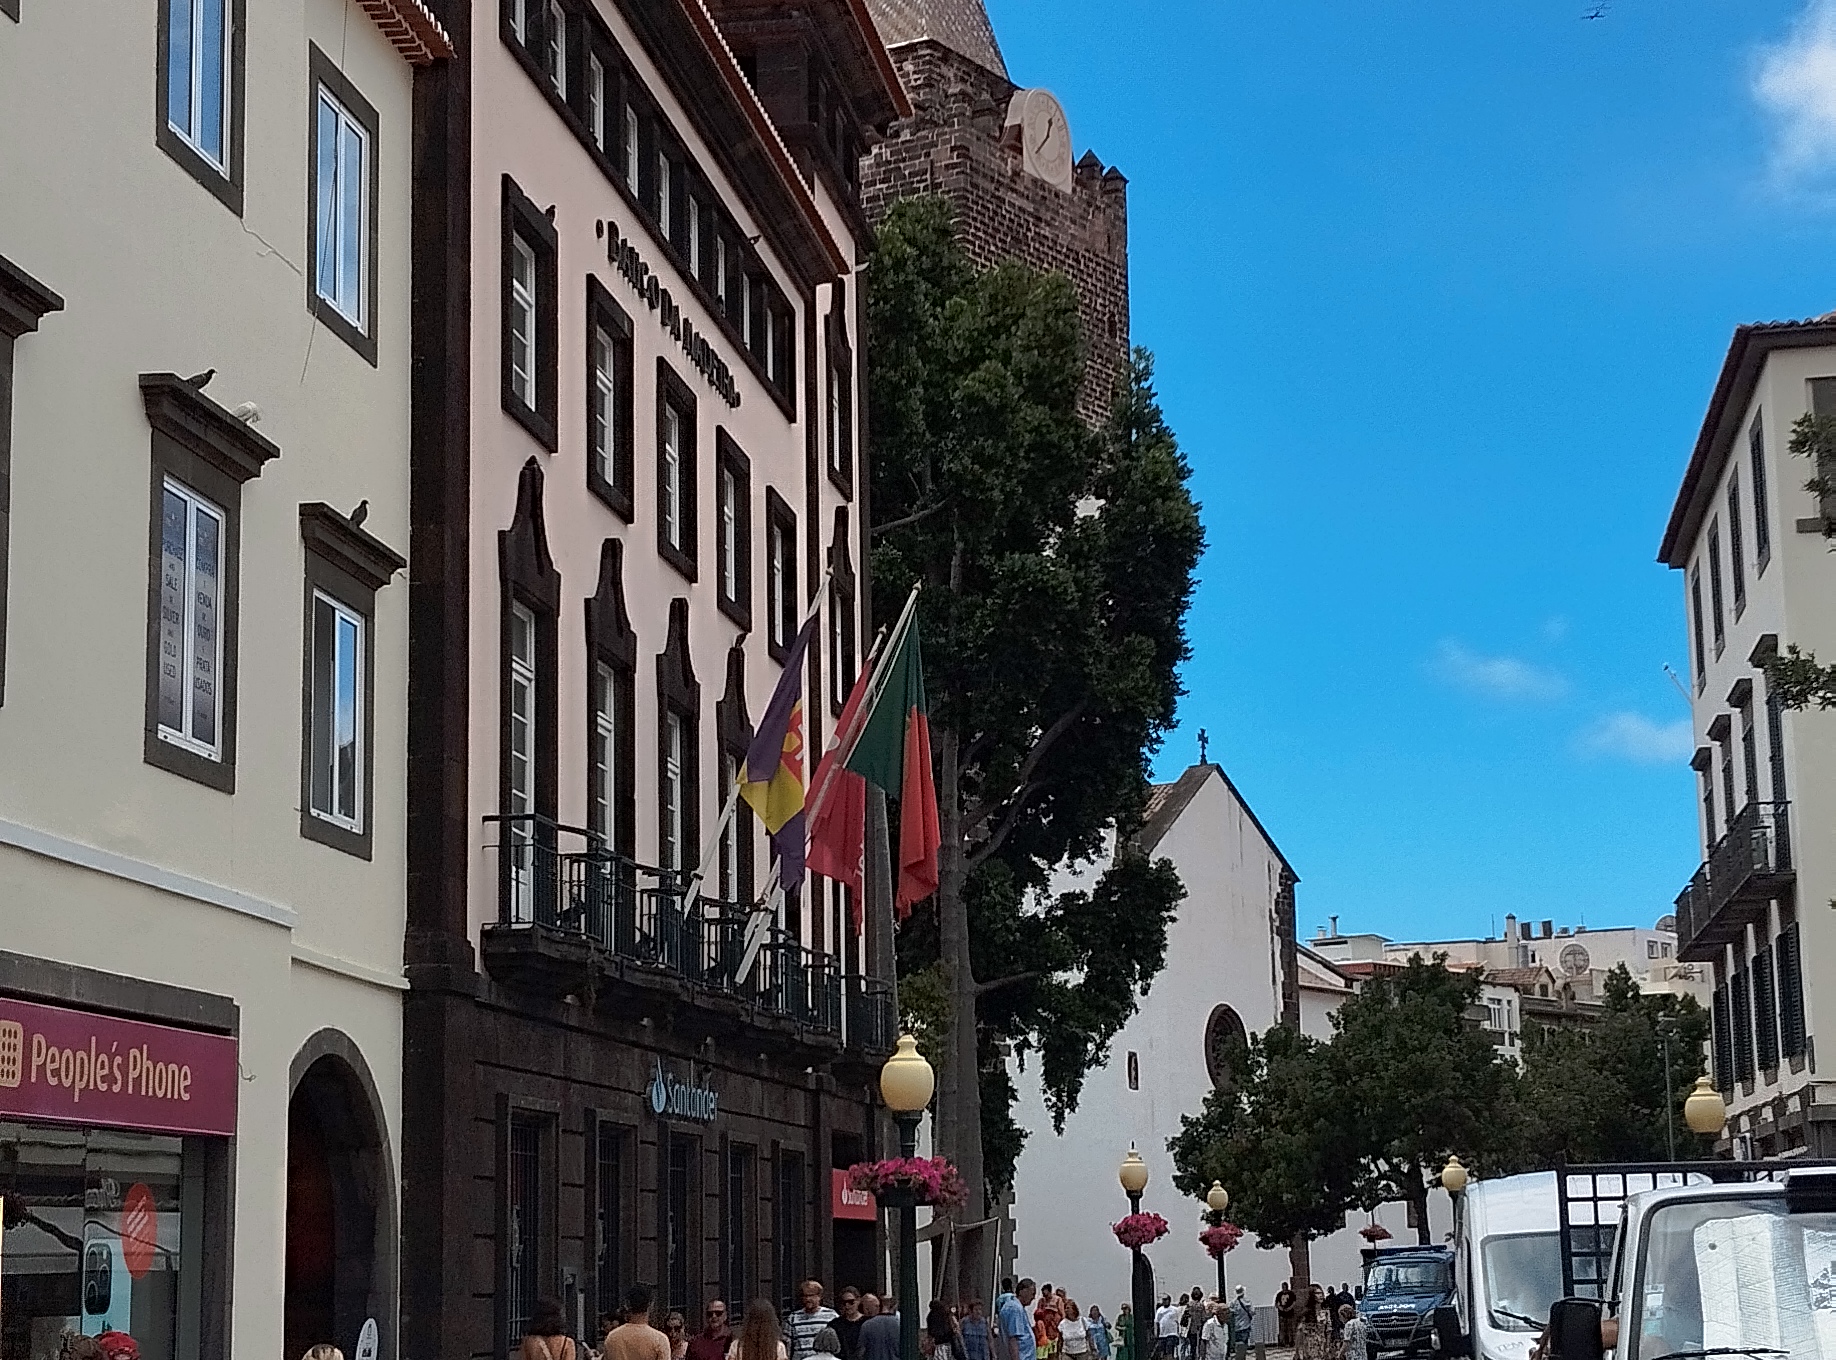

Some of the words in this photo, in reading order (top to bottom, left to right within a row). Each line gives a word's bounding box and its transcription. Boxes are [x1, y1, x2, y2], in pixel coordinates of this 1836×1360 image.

[30, 1033, 123, 1103] People's
[127, 1043, 192, 1101] Phone
[667, 1072, 719, 1121] Santander
